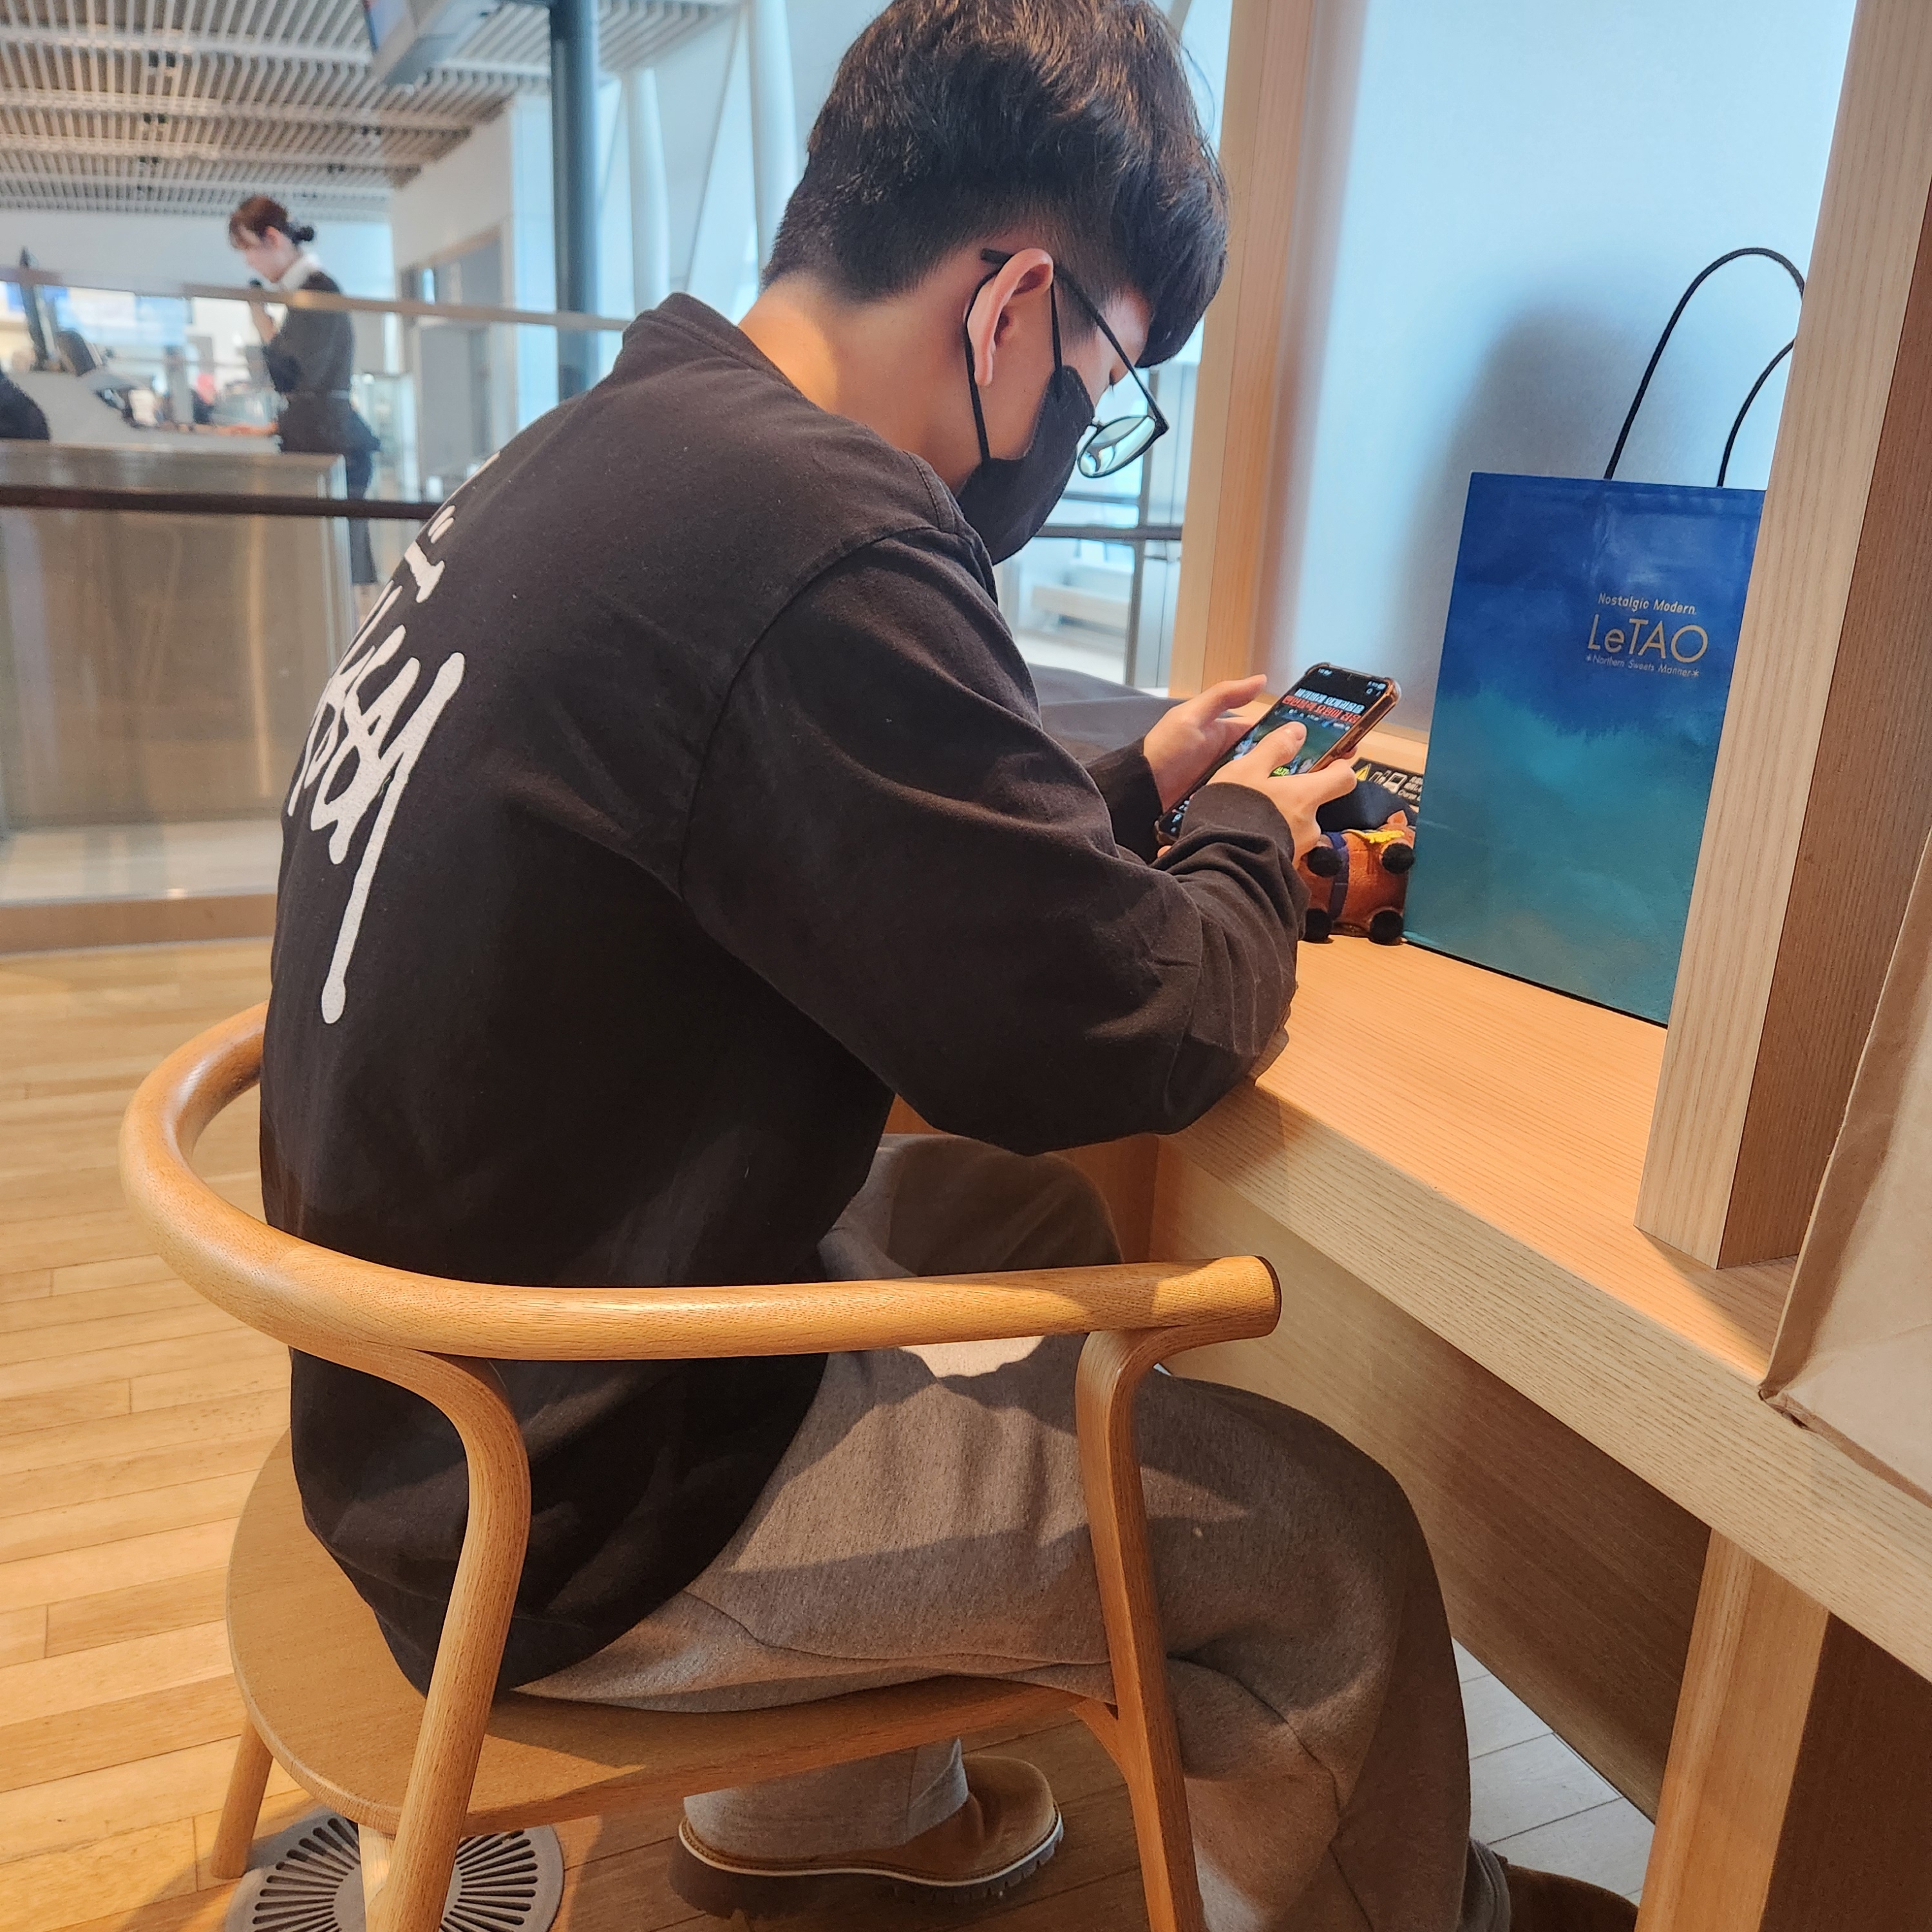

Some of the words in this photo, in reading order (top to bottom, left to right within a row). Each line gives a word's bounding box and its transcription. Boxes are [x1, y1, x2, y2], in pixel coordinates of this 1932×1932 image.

[1598, 592, 1649, 612] Nostalgic
[1587, 614, 1708, 663] LeTAO
[1593, 654, 1625, 667] Northern
[1628, 659, 1654, 671] Sweets
